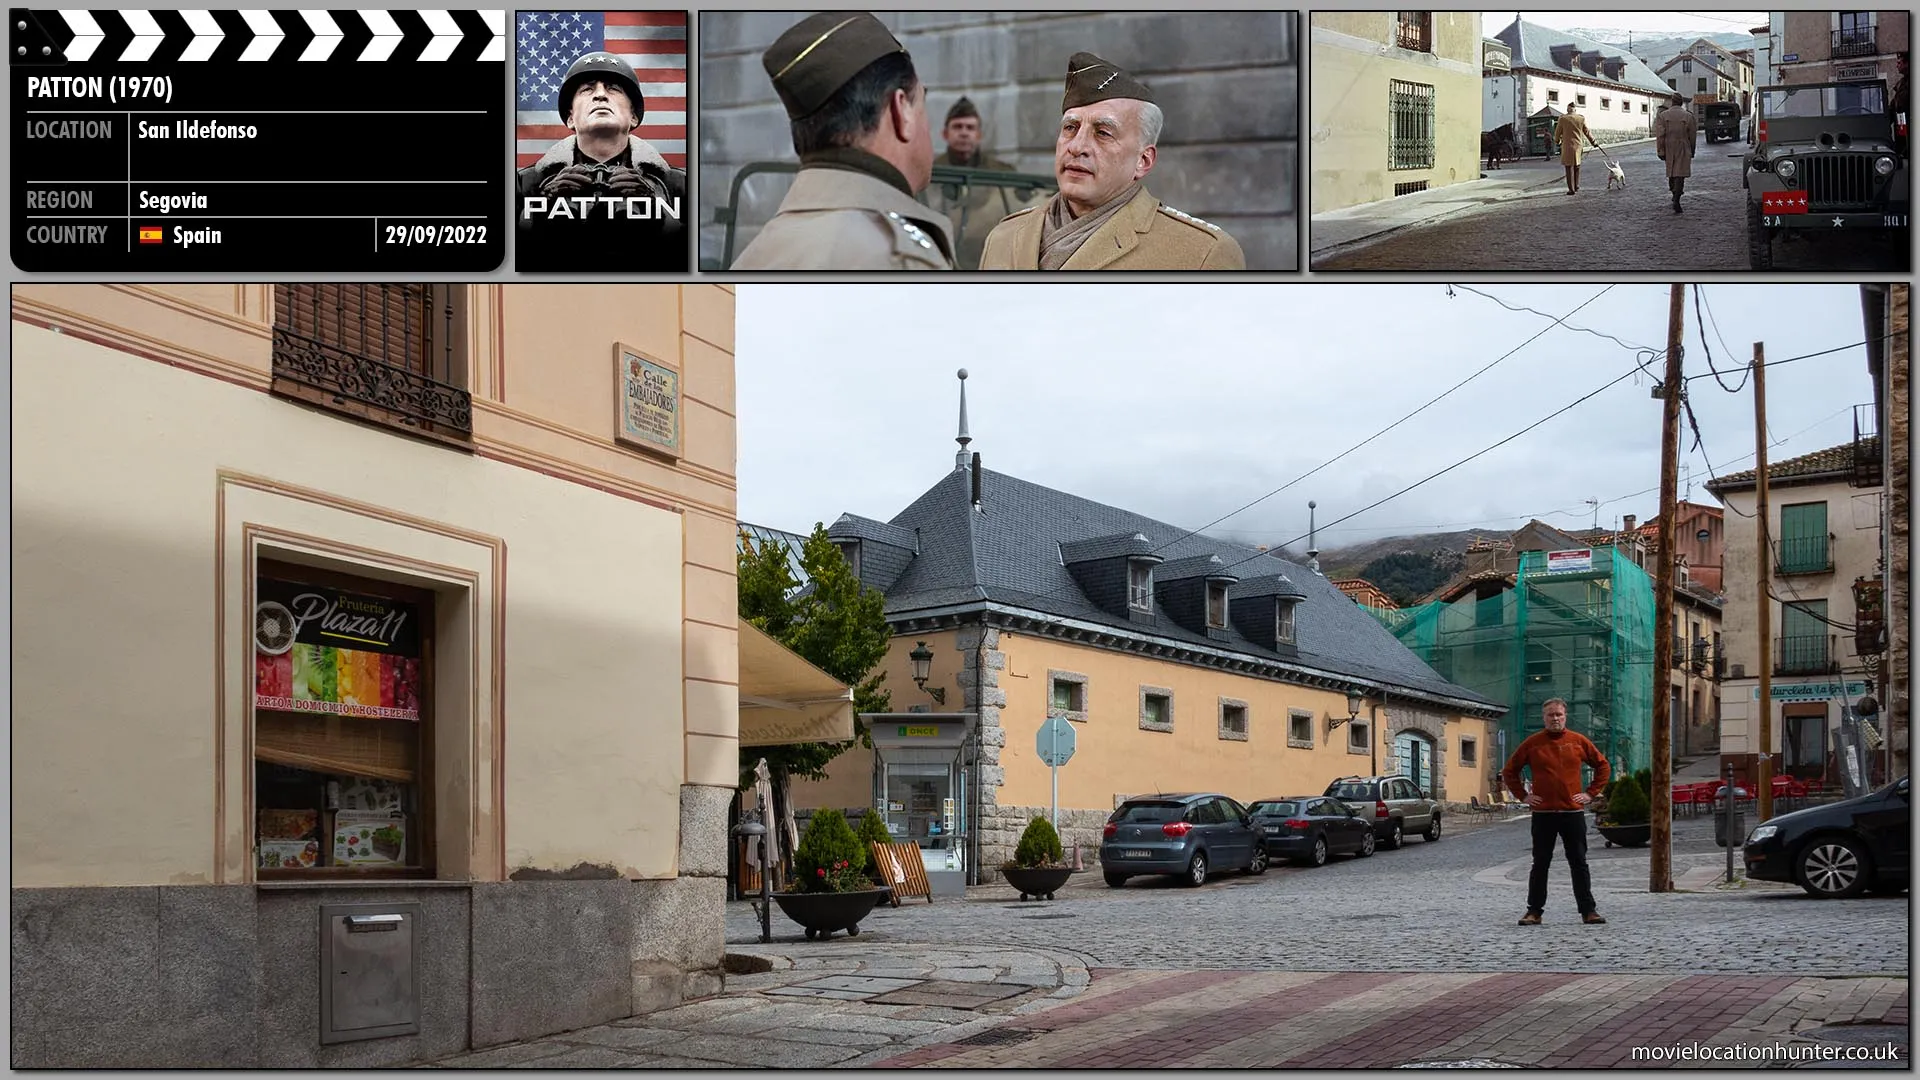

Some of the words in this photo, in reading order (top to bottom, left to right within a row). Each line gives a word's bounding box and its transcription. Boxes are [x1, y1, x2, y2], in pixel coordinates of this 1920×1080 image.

[523, 196, 681, 220] PATTON
[644, 370, 668, 387] Calle
[629, 380, 674, 413] EMBAJADORES
[285, 698, 293, 708] A
[295, 699, 350, 714] DOMICILIO
[351, 704, 359, 715] Y
[910, 727, 936, 736] ONCE
